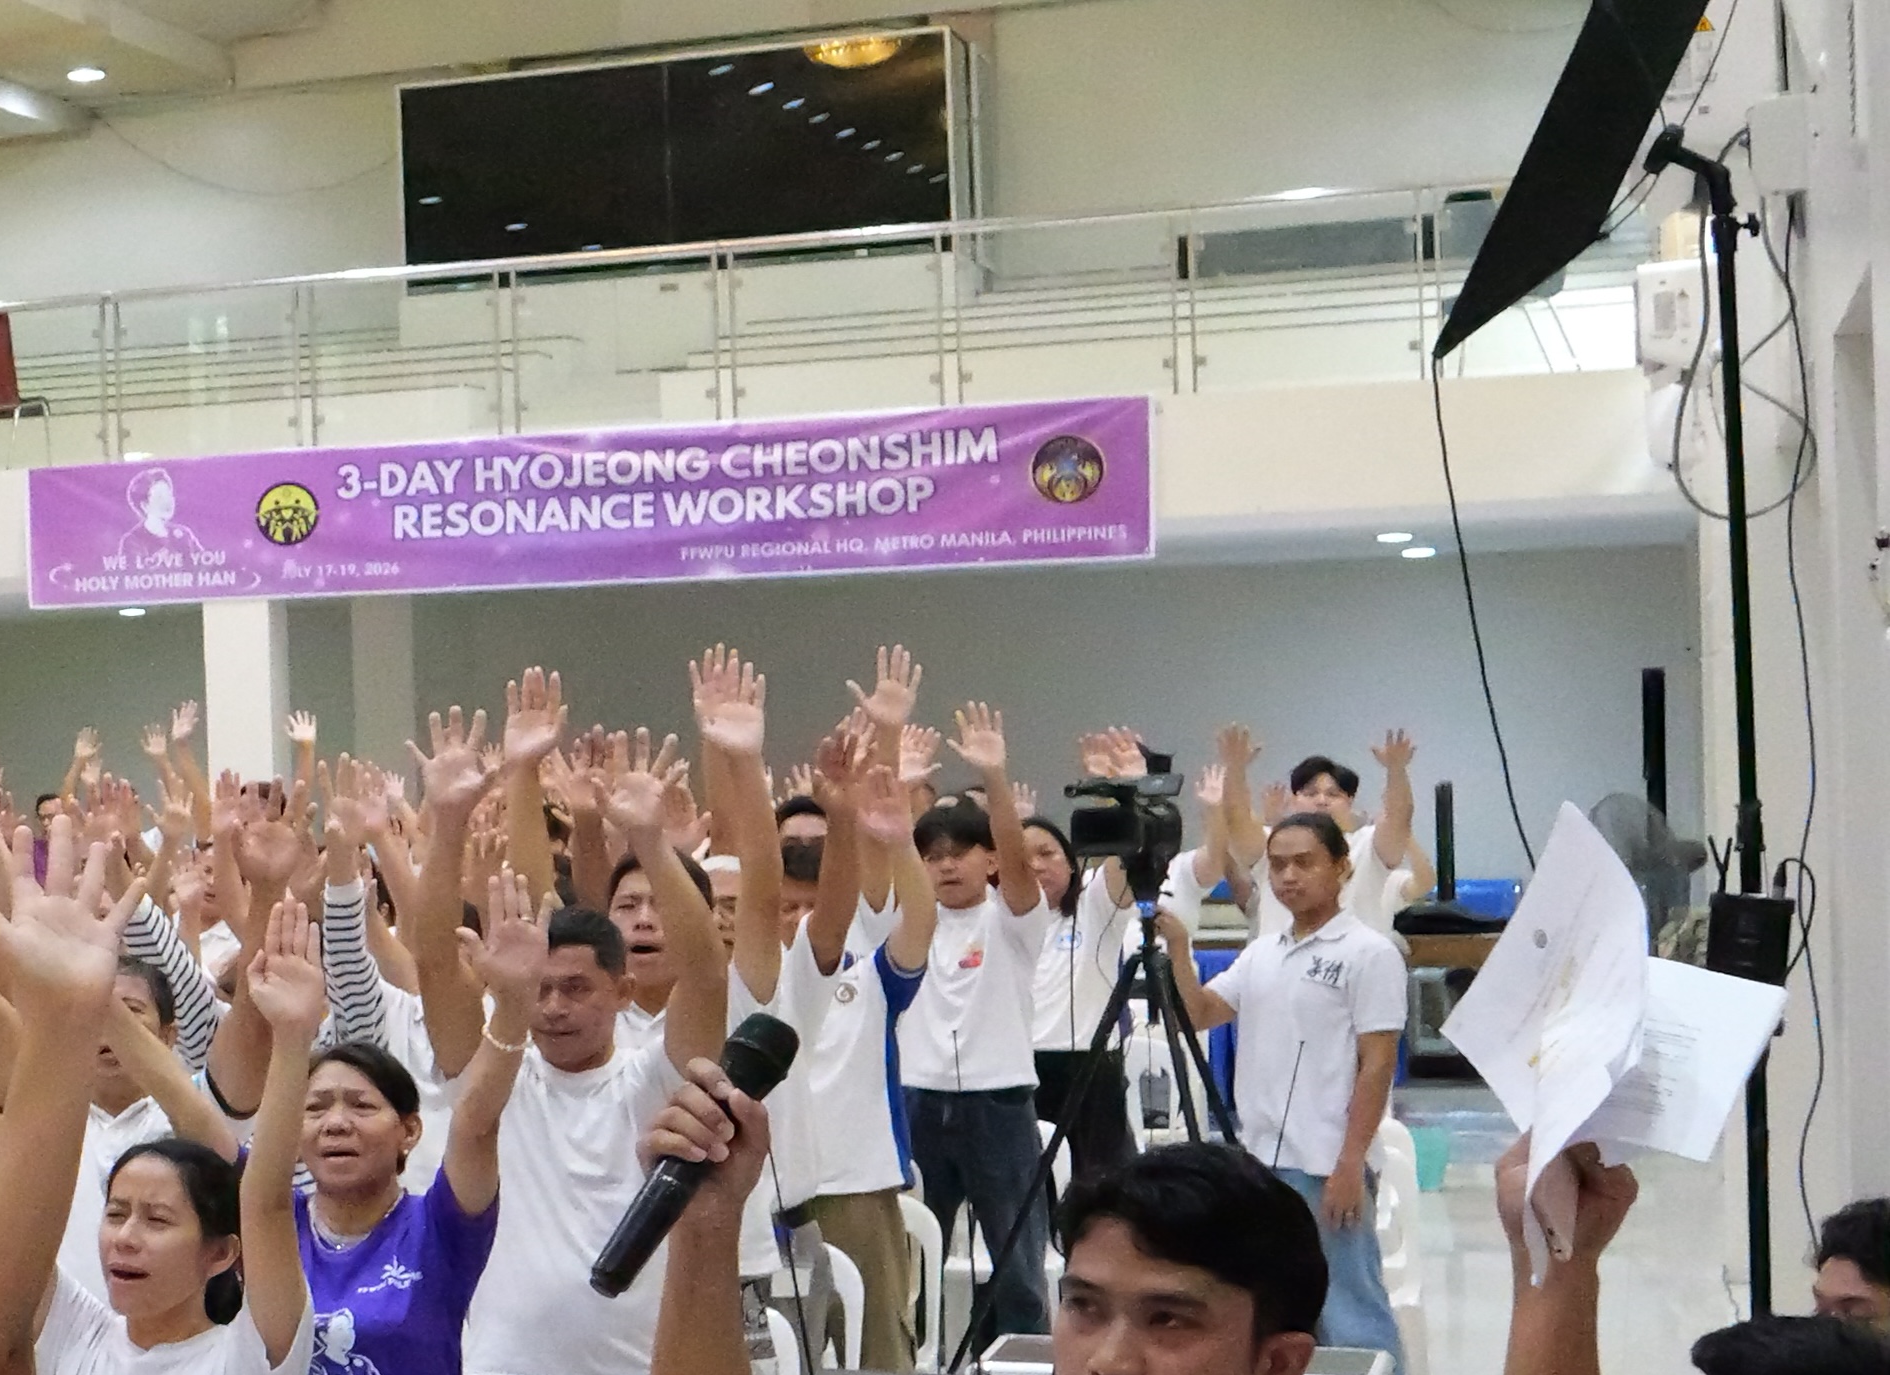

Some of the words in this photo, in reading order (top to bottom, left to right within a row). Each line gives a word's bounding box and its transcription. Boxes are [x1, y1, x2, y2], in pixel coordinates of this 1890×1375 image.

[336, 458, 464, 500] 3-DAY
[474, 446, 710, 493] HYOJEONG
[720, 425, 1000, 479] CHEONSHIM
[393, 492, 655, 540] RESONANCE
[662, 476, 936, 527] WORKSHOP
[740, 540, 832, 558] REGIONAL
[874, 534, 935, 552] METRO
[1022, 524, 1128, 545] PHILIPPINES
[102, 554, 128, 572] WE
[135, 551, 184, 570] LOVE
[191, 550, 226, 566] YOU
[74, 575, 120, 593] HOLY
[124, 573, 194, 591] MOTHER
[198, 570, 237, 587] HAN
